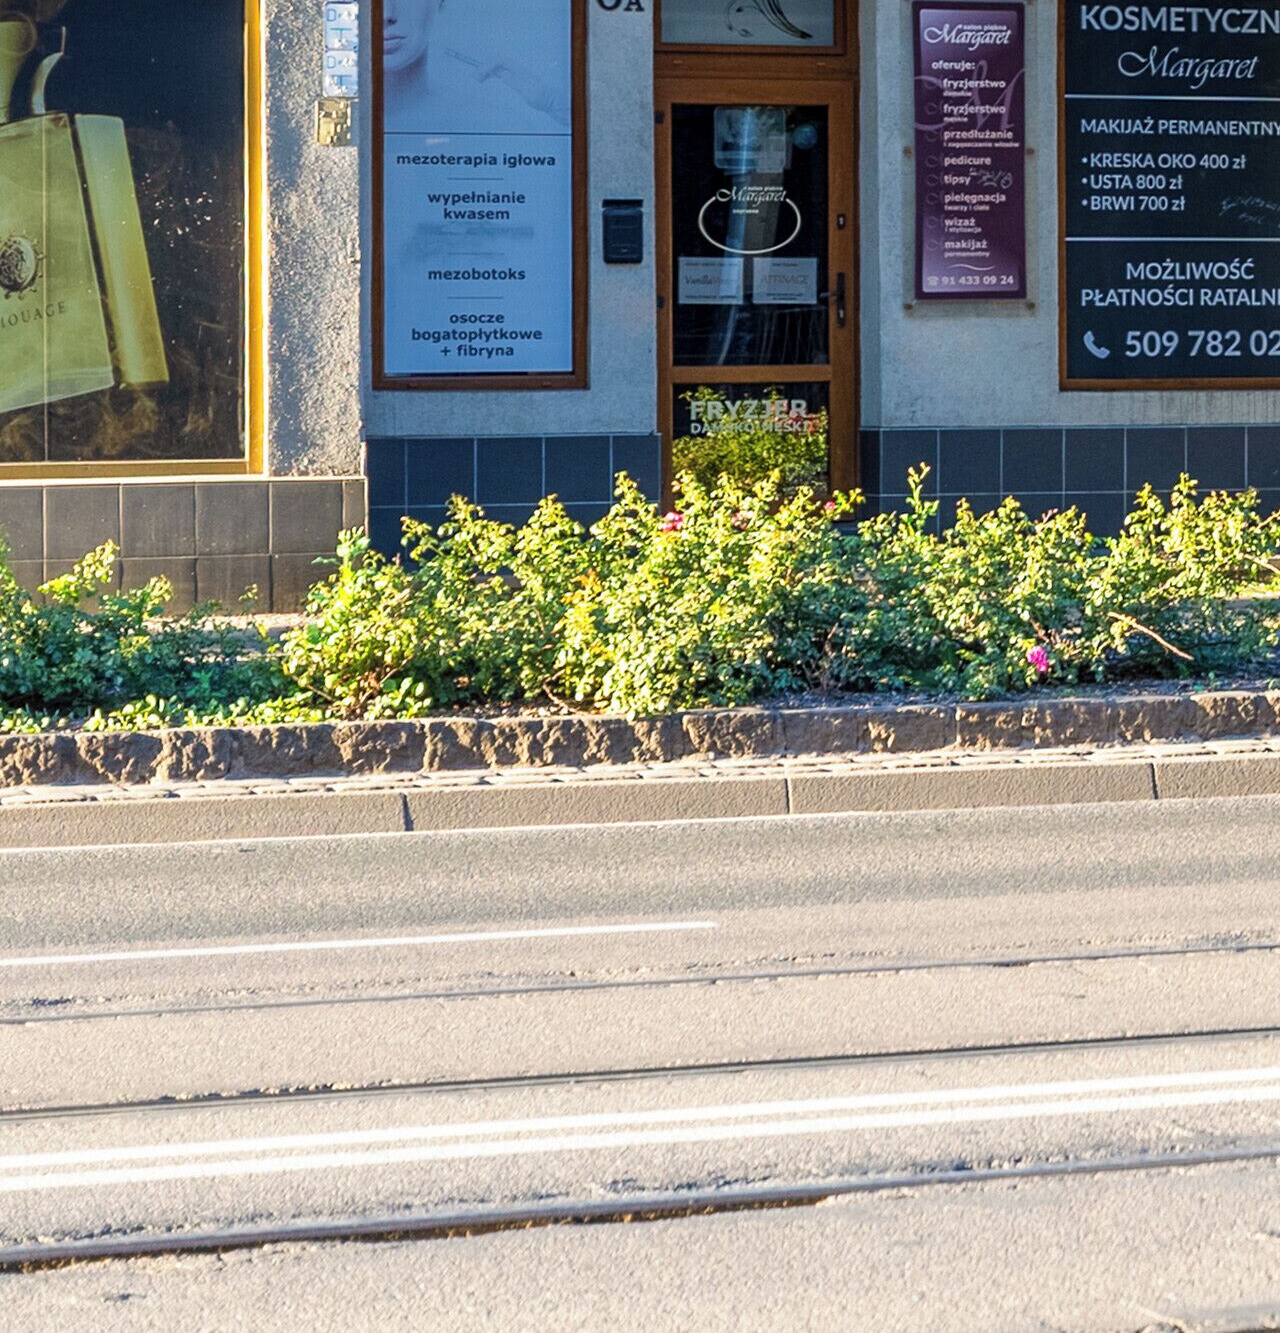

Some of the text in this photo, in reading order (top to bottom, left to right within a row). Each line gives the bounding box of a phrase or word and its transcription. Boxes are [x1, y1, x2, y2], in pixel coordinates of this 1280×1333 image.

[923, 23, 1012, 52] Margaret
[931, 60, 976, 72] oferuje:
[1117, 45, 1260, 90] Margaret
[942, 78, 1006, 90] fryzjerstwo
[942, 104, 1007, 115] fryzjerstwo
[1080, 116, 1155, 135] MAKIJAŻ
[943, 129, 1014, 141] przedłużanie
[396, 153, 557, 169] mezoterapia igłowa
[943, 155, 992, 166] pedicure
[1090, 152, 1247, 170] KRESKA OKO 400 zł
[943, 175, 971, 185] tipsy
[1090, 174, 1184, 190] USTA 800 zł
[427, 191, 526, 206] wypełnianie
[716, 185, 787, 208] Margaret
[943, 192, 1007, 204] pielęgnacja
[1090, 195, 1186, 212] BRWI 700 zł
[443, 207, 511, 221] kwasem
[944, 217, 976, 227] wizaż
[944, 239, 988, 250] makijaż
[428, 268, 526, 281] mezobotoks
[1126, 257, 1255, 281] MOŻLIWOŚĆ
[941, 275, 1014, 285] 91 433 09 24
[1081, 284, 1194, 307] PŁATNOŚCI
[449, 313, 506, 325] osocze
[411, 328, 543, 344] bogatopłytkowe
[1124, 330, 1180, 358] 509
[1187, 330, 1242, 358] 782
[457, 345, 515, 359] fibryna
[690, 399, 811, 421] FRYZJER
